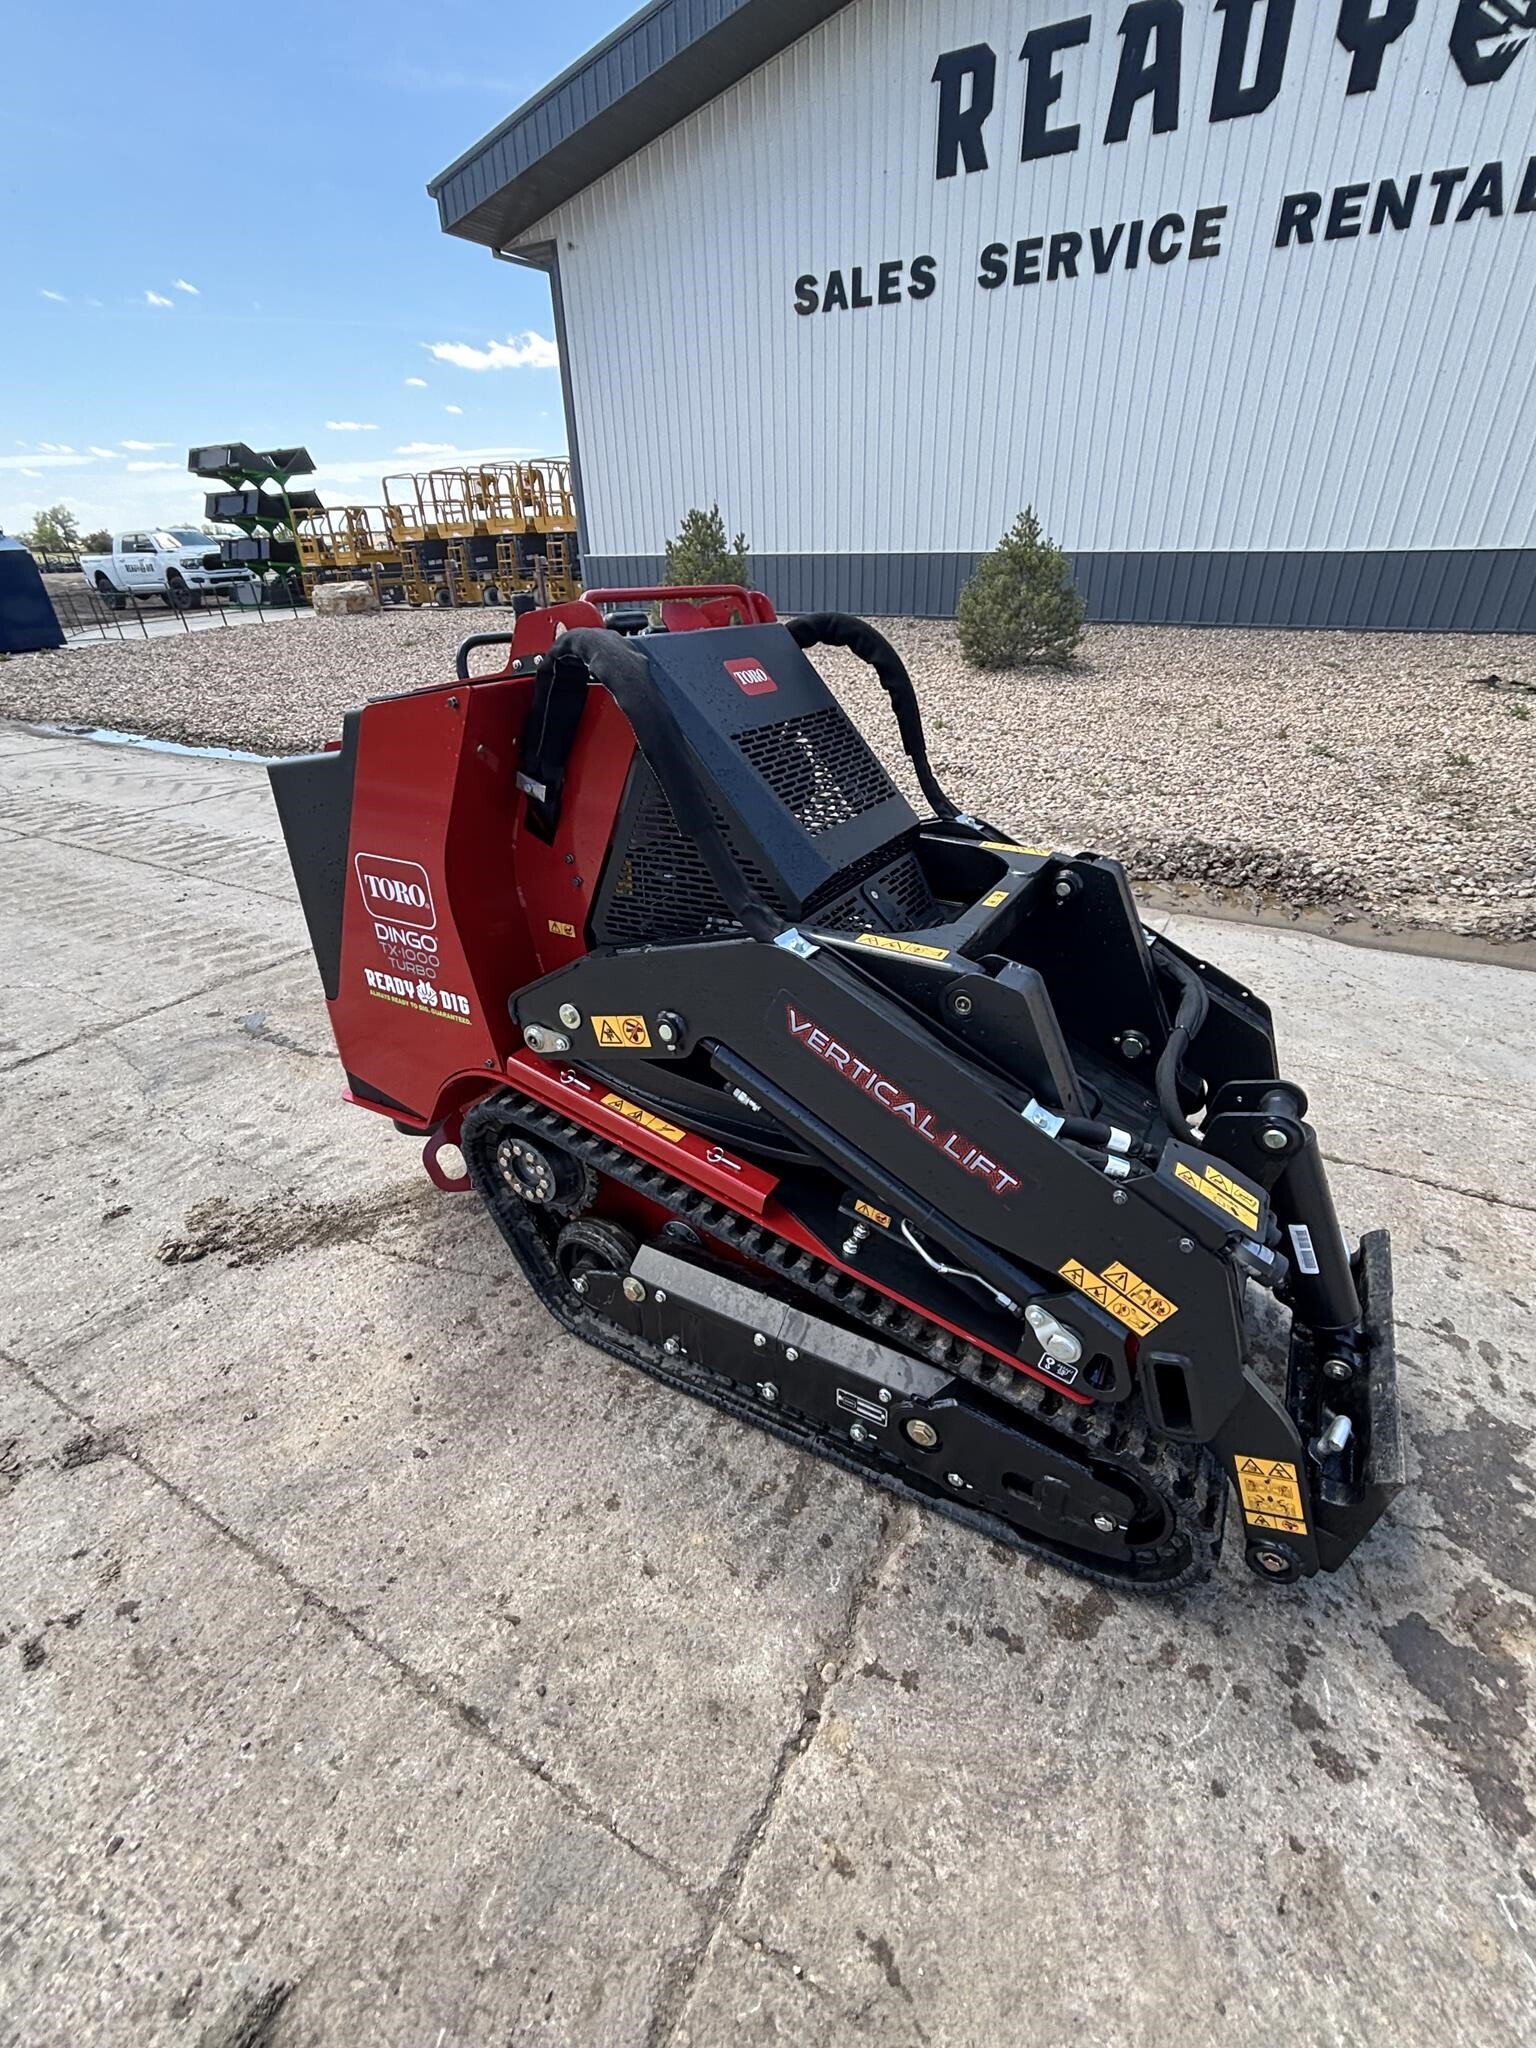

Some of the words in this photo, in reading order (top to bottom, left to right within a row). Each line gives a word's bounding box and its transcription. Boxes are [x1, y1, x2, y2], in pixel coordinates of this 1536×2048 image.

[931, 0, 1419, 181] READY
[793, 255, 937, 316] SALES
[977, 205, 1228, 290] SERVICE
[733, 668, 768, 685] TORO
[364, 874, 426, 908] TORO
[374, 922, 437, 953] DINGO
[388, 956, 436, 979] TURBO
[364, 967, 415, 999] READY
[439, 990, 470, 1015] DIG
[410, 1001, 418, 1010] TO
[789, 1007, 937, 1141] VERTICAL
[942, 1132, 1019, 1193] LIFT
